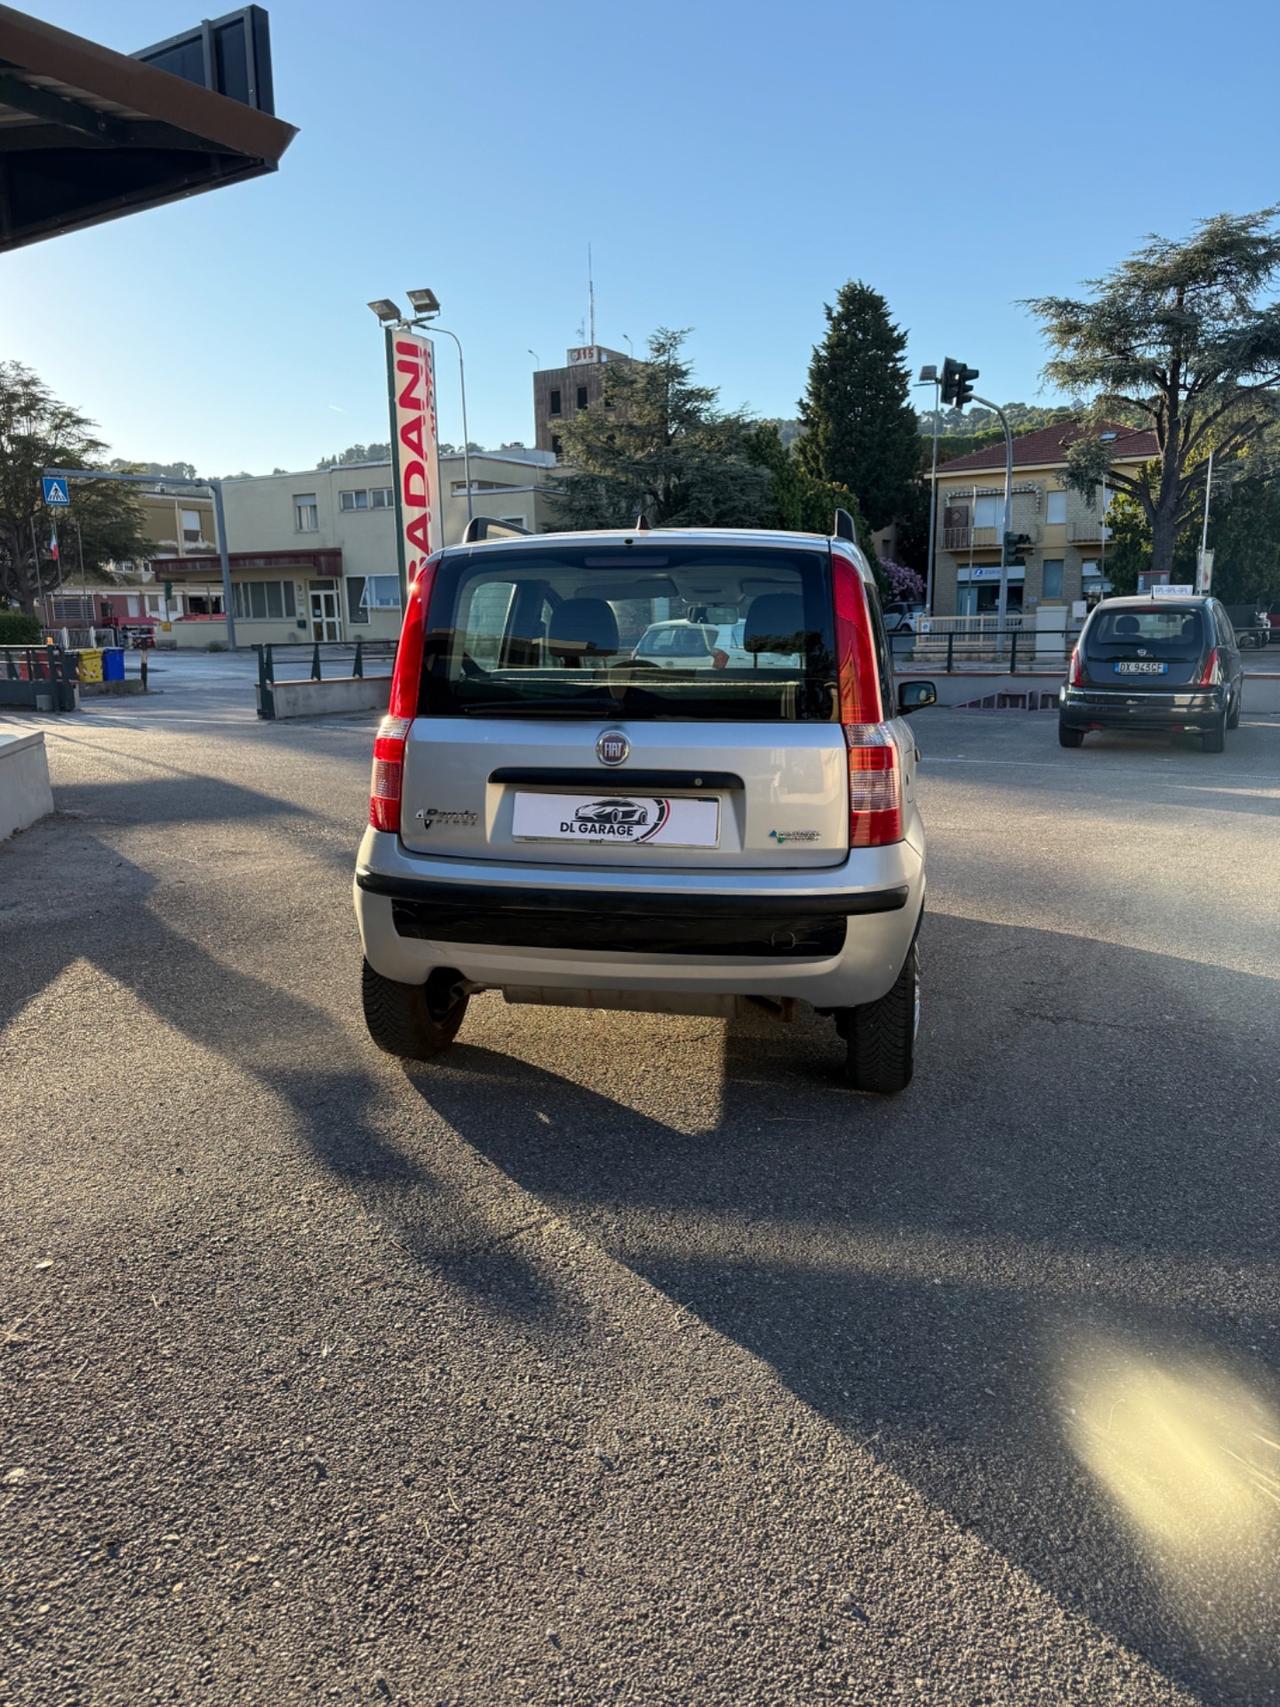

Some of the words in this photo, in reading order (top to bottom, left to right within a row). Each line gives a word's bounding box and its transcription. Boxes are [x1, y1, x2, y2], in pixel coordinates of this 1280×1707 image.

[396, 340, 429, 583] ADANI
[604, 742, 623, 757] FIAT
[560, 822, 575, 833] DL
[578, 823, 634, 836] GARAGE
